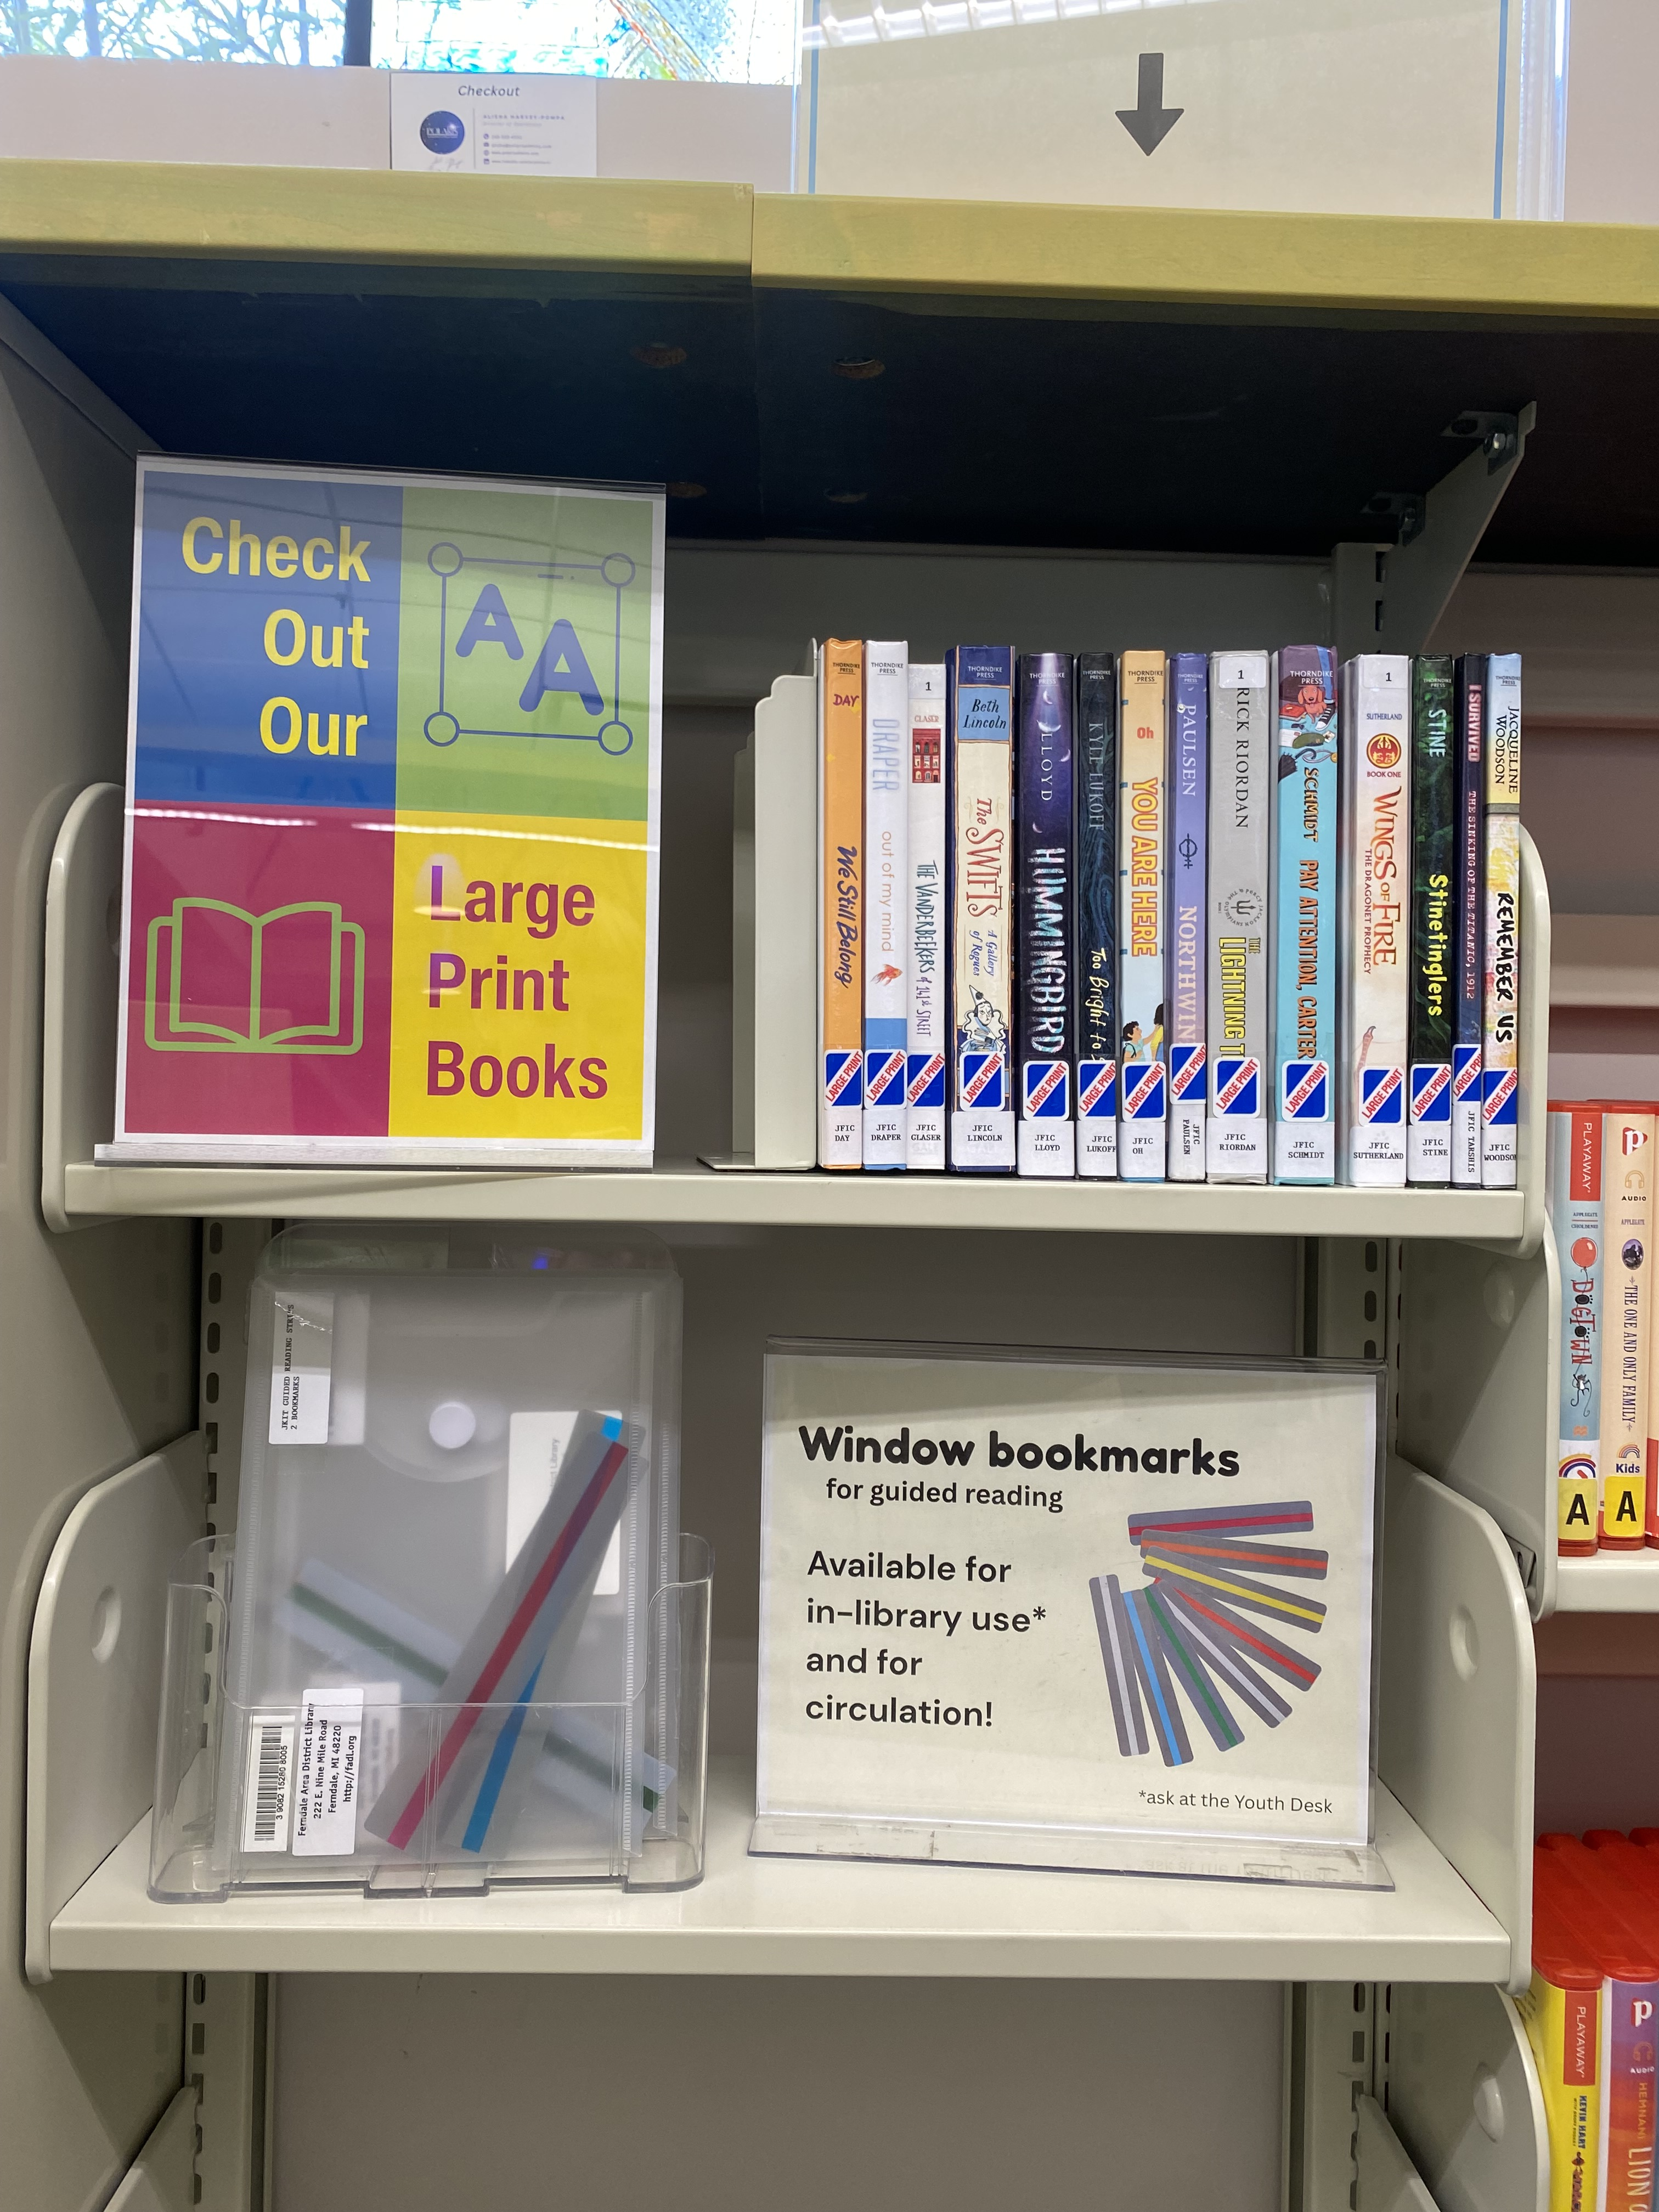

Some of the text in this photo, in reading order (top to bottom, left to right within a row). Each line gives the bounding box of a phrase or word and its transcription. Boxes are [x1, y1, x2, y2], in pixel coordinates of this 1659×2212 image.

[458, 87, 520, 97] Checkout
[182, 516, 371, 582] Check
[263, 610, 369, 670] Out
[833, 693, 860, 707] DAY
[962, 715, 1006, 729] Lincoln
[971, 698, 1000, 713] Beth
[259, 696, 368, 757] Our
[1137, 727, 1154, 740] Oh
[1184, 704, 1197, 797] PAULSEN
[1428, 709, 1447, 758] STINE
[1468, 693, 1481, 762] SURVIVED
[1495, 715, 1507, 785] WOODSON
[1507, 706, 1519, 793] JACQUELINE
[872, 719, 900, 791] DRAPER
[1041, 732, 1053, 801] LLOYD
[1088, 723, 1104, 831] KYLE LUKOFF
[1235, 688, 1250, 829] RICK RIORDAN
[1304, 767, 1319, 843] SCHMIDT
[966, 798, 1005, 917] The SWIFTS
[1131, 777, 1158, 957] YOU ARE HERE
[1468, 816, 1476, 866] SINKING
[879, 831, 895, 952] out of my mind
[917, 860, 938, 879] THE
[1245, 889, 1262, 902] PERCY
[1371, 785, 1402, 966] WINGS OF FIRE
[1468, 870, 1475, 884] OF
[430, 865, 595, 939] Large
[834, 846, 859, 989] We Still Belong
[1245, 905, 1263, 927] JACKSON
[1364, 870, 1372, 923] DRAGONET
[914, 883, 939, 973] VANDERBEEKERS
[968, 930, 983, 977] of Rogues
[983, 930, 997, 977] A Gallery
[1027, 848, 1067, 1053] HUMMINGBIRD
[1248, 938, 1261, 954] THE
[1363, 926, 1372, 974] PROPHECY
[1423, 874, 1448, 1017] Stinetinglers
[1465, 913, 1475, 967] TITANIC,
[428, 953, 570, 1013] Print
[1091, 947, 1107, 969] Too
[1179, 906, 1197, 1042] NORTHWIN
[1296, 860, 1318, 1059] PAY ATTENTION, CARTER
[1496, 893, 1515, 1042] REMEMBER US
[1085, 976, 1109, 1026] Bright
[1218, 936, 1246, 1040] LIGHTNING
[1466, 972, 1475, 999] 1912
[916, 1009, 932, 1036] STREET
[1090, 1034, 1107, 1049] to
[426, 1040, 608, 1100] Books
[825, 1051, 862, 1102] LARGE PRINT
[866, 1051, 906, 1102] LARGE PRINT
[1285, 1062, 1328, 1113] LARGE PRINT
[1583, 1122, 1593, 1189] PLAYAWAY
[1622, 1285, 1638, 1424] THE ONE AND ONLY FAMILY
[291, 1376, 300, 1420] BOOKMARKS
[799, 1425, 1240, 1477] Window bookmarks
[1616, 1463, 1640, 1474] Kids
[826, 1478, 1063, 1513] for guided reading
[1566, 1494, 1590, 1525] A
[1616, 1491, 1637, 1522] A
[807, 1550, 1012, 1583] Available for
[808, 1598, 962, 1637] in-library
[806, 1648, 922, 1675] and for
[806, 1694, 992, 1726] circulation!
[298, 1703, 315, 1836] Ferndale Area District Library
[314, 1720, 328, 1819] 222 E. Nine Mile Road
[331, 1758, 339, 1769] MI
[343, 1736, 357, 1802] http://fadl.org
[328, 1773, 339, 1813] Ferndale,
[1180, 1793, 1196, 1806] at
[1201, 1793, 1229, 1808] the
[1234, 1795, 1284, 1810] Youth
[1291, 1798, 1333, 1814] Desk
[1575, 2006, 1586, 2074] PLAYAWAY
[1578, 2095, 1588, 2149] KEVIN HART
[1627, 2147, 1652, 2196] LION
